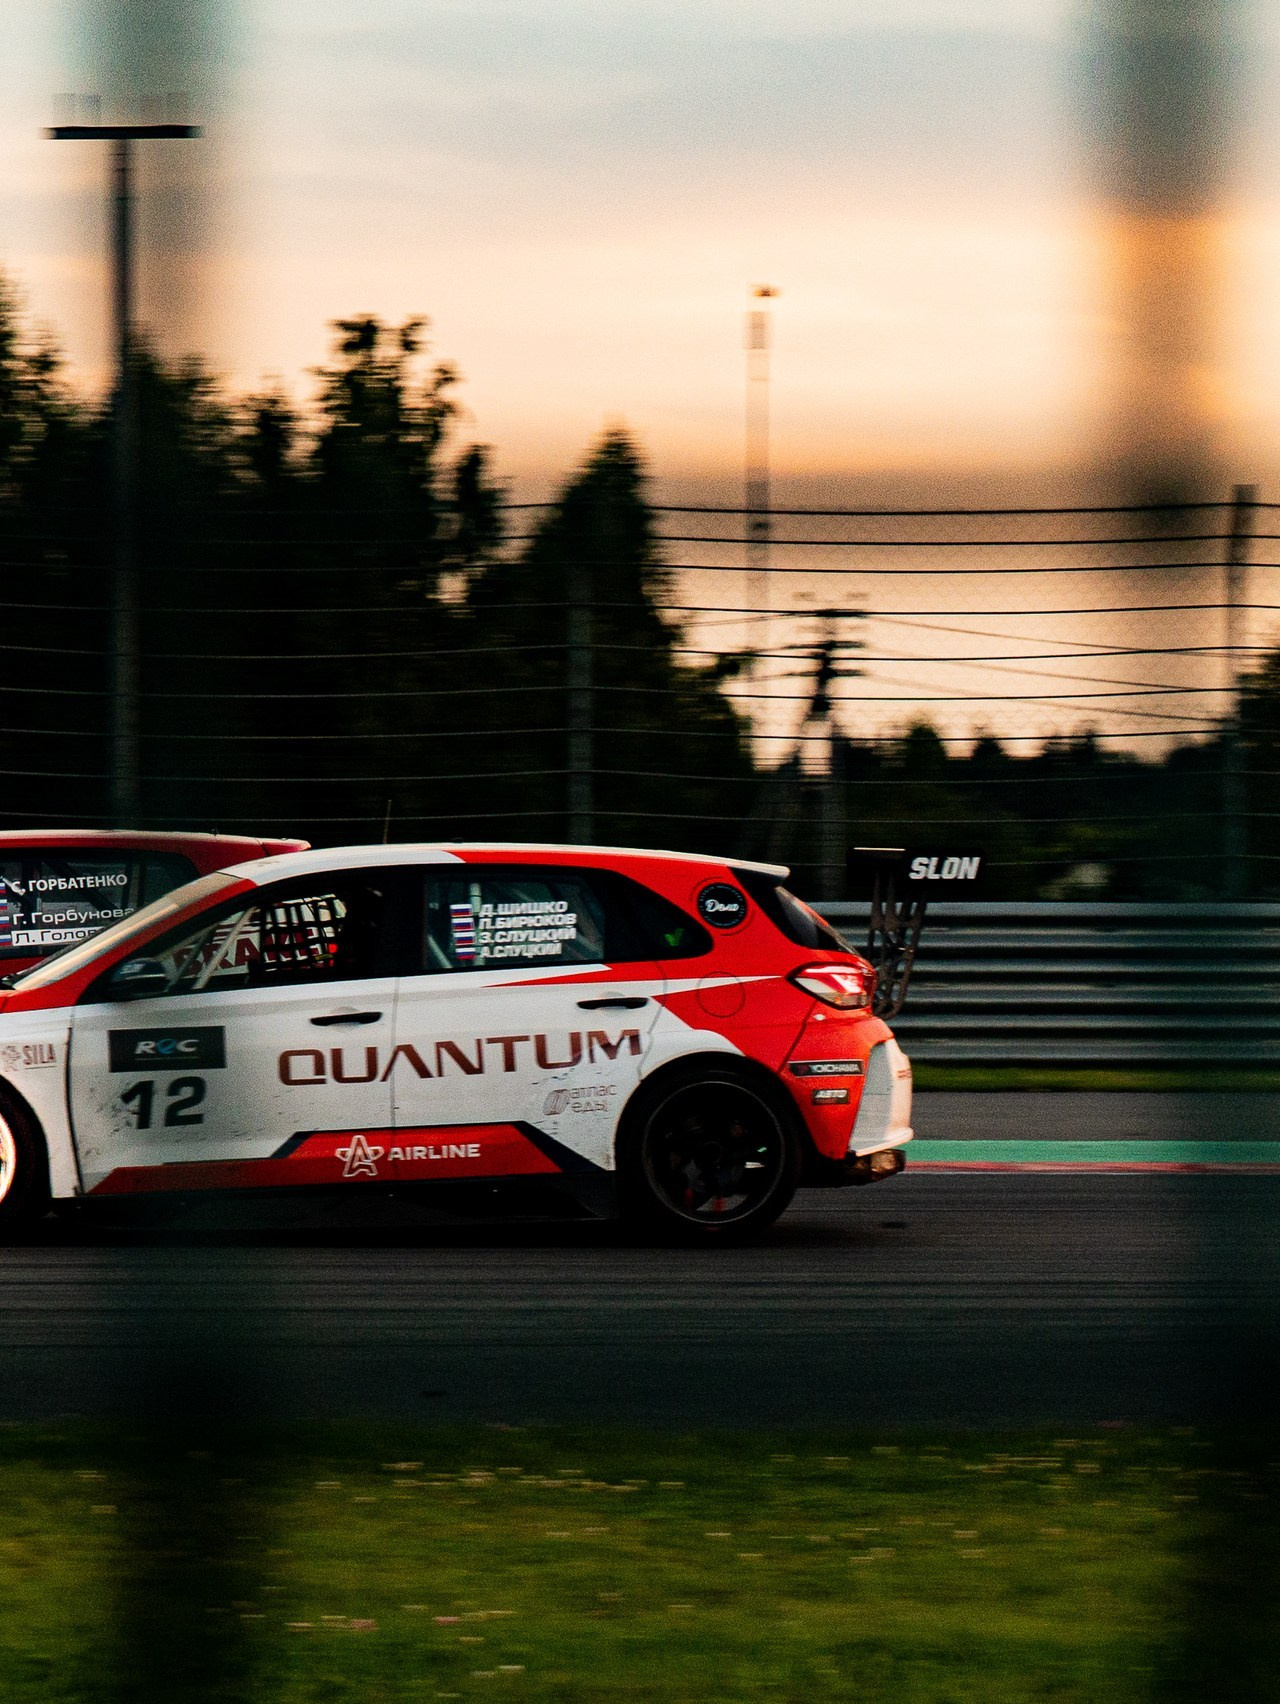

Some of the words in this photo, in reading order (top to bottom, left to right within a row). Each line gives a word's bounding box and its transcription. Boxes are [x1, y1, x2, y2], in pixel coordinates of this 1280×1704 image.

[909, 857, 981, 879] SLON
[28, 874, 128, 892] ГОРБАТЕНКО
[22, 1044, 56, 1065] SILA
[279, 1029, 642, 1086] QUANTUM
[121, 1076, 207, 1129] 12
[387, 1144, 481, 1160] AIRLINE
